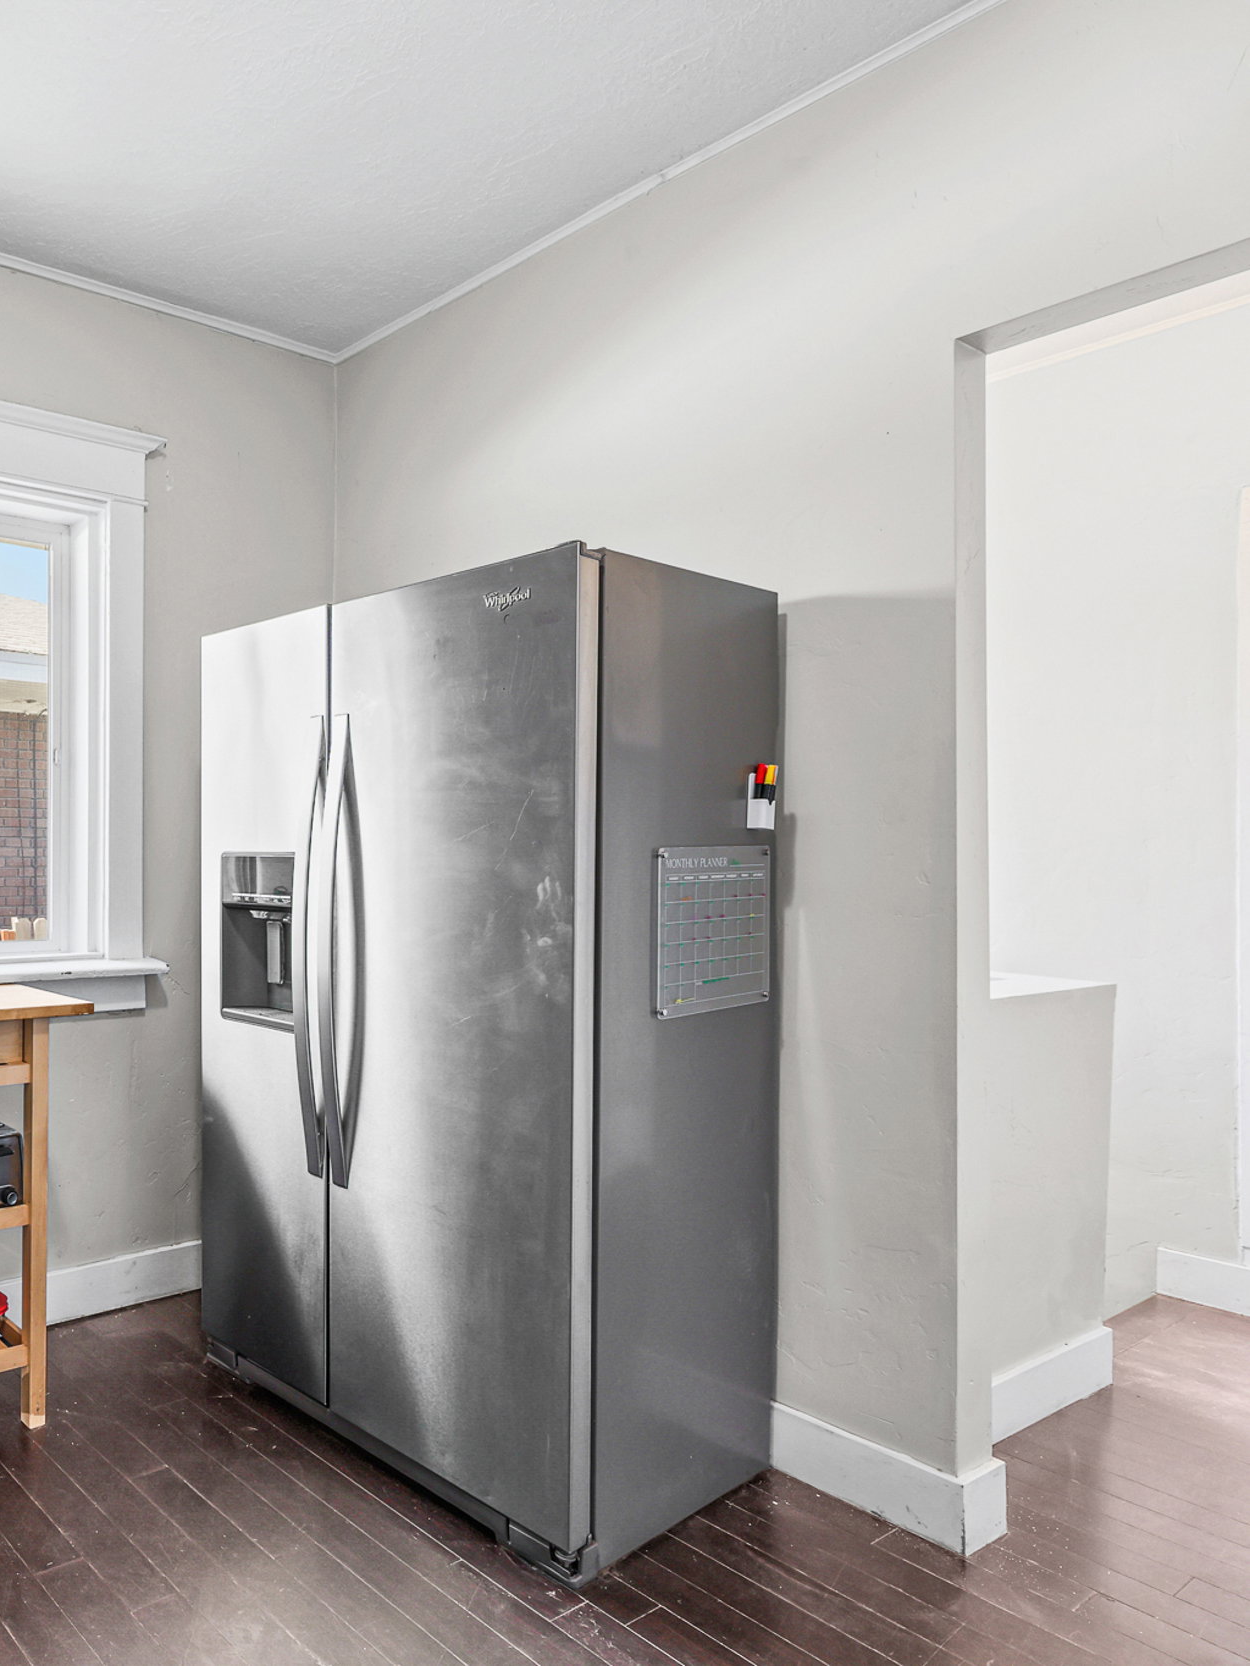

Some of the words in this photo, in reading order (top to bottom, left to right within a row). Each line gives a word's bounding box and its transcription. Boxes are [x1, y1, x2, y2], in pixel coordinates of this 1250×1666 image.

[483, 587, 531, 611] Whirlpool
[666, 857, 698, 869] MONTHLY
[700, 857, 728, 868] PLANNER
